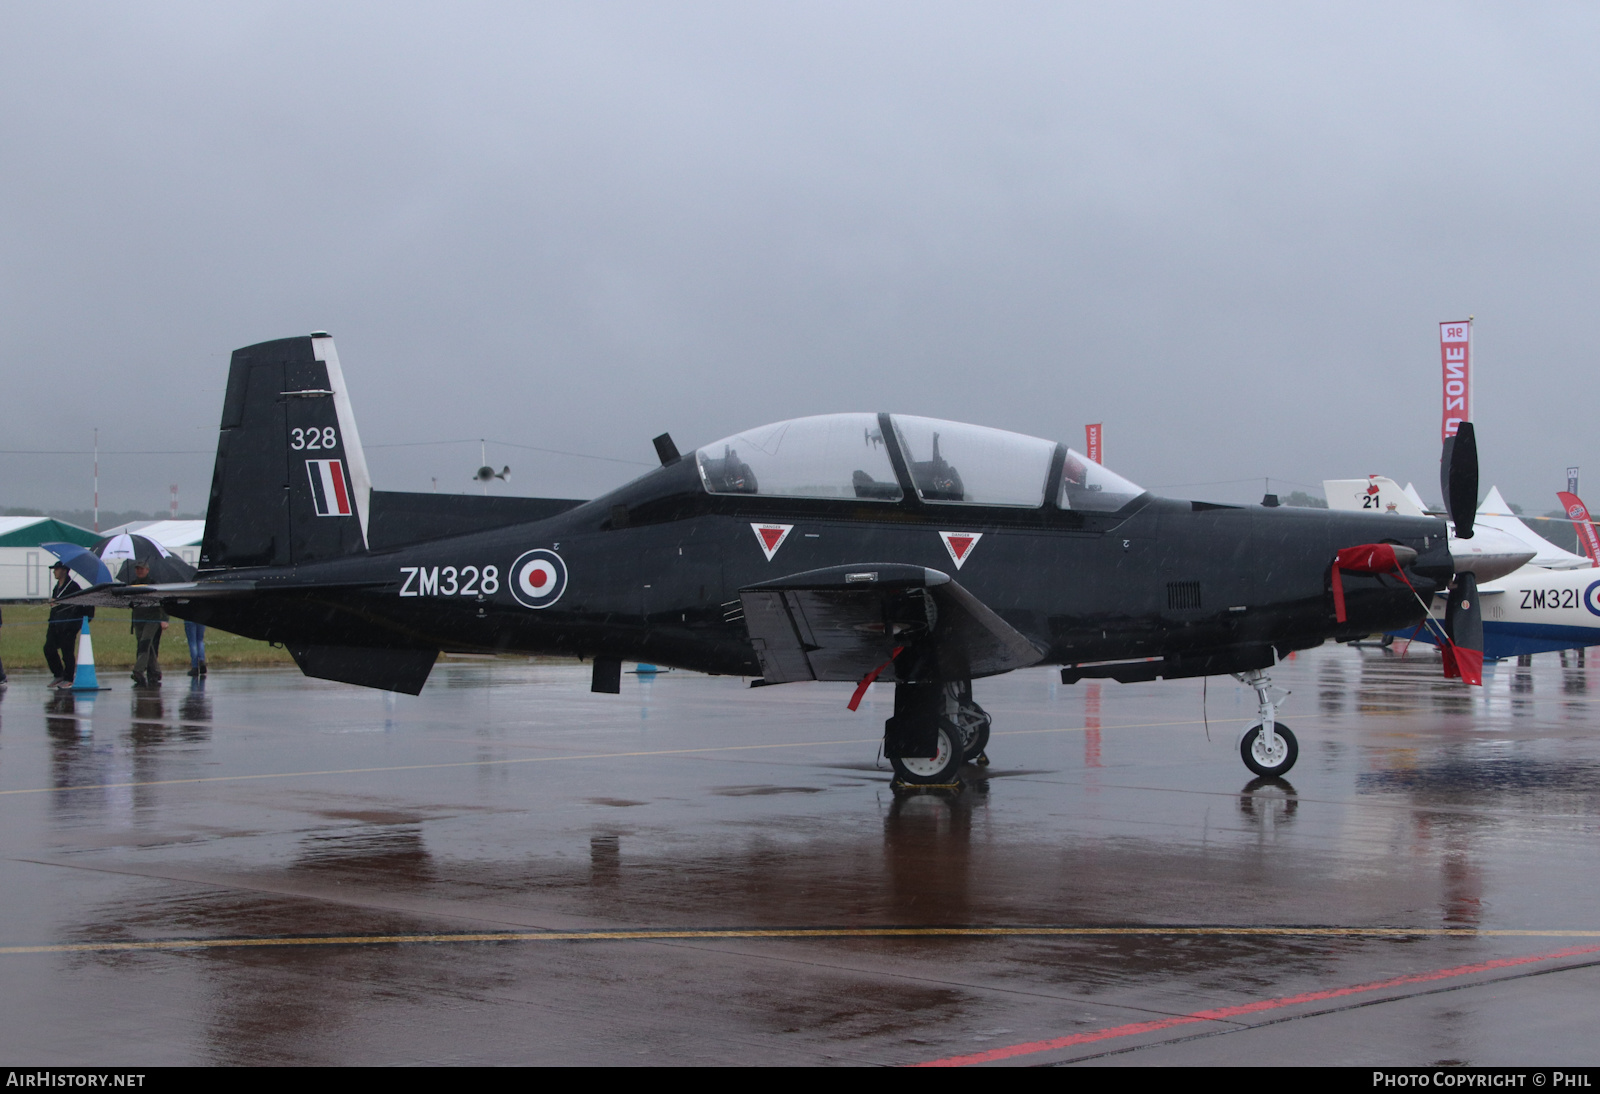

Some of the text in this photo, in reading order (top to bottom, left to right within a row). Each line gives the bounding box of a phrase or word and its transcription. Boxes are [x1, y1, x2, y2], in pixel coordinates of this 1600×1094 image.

[291, 426, 337, 450] 328
[1363, 495, 1379, 509] 21
[757, 533, 767, 550] DANGER
[773, 534, 785, 550] DANGER
[946, 541, 956, 558] DANGER
[963, 542, 975, 559] DANGER
[399, 564, 499, 597] ZM328
[1520, 589, 1579, 609] ZM321
